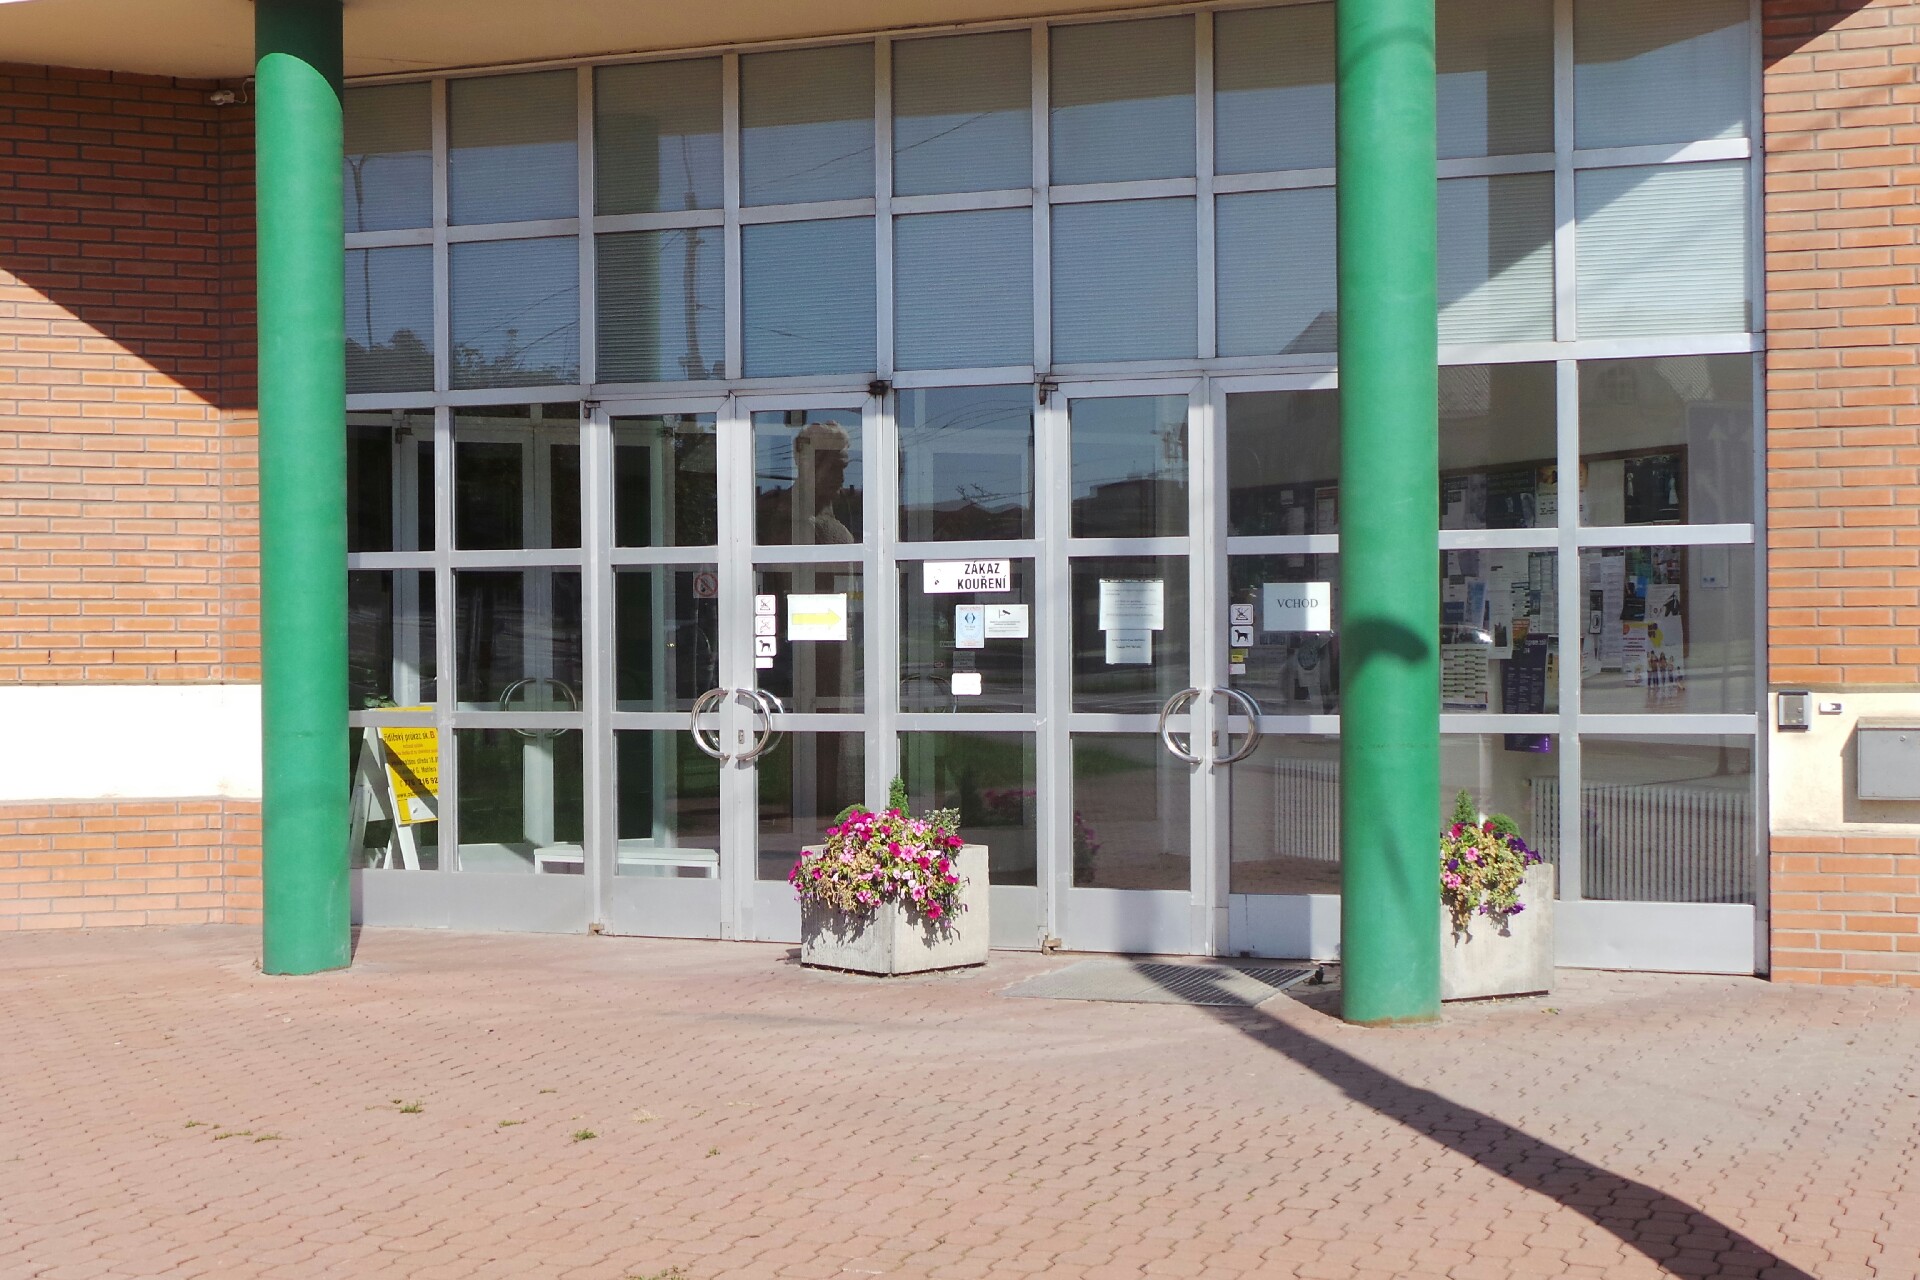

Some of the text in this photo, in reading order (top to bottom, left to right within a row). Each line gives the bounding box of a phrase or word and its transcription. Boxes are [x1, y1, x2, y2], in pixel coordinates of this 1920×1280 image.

[964, 560, 1000, 575] ZÁKAZ
[957, 574, 1007, 590] KOUŘENÍ
[1277, 598, 1319, 609] VCHOD
